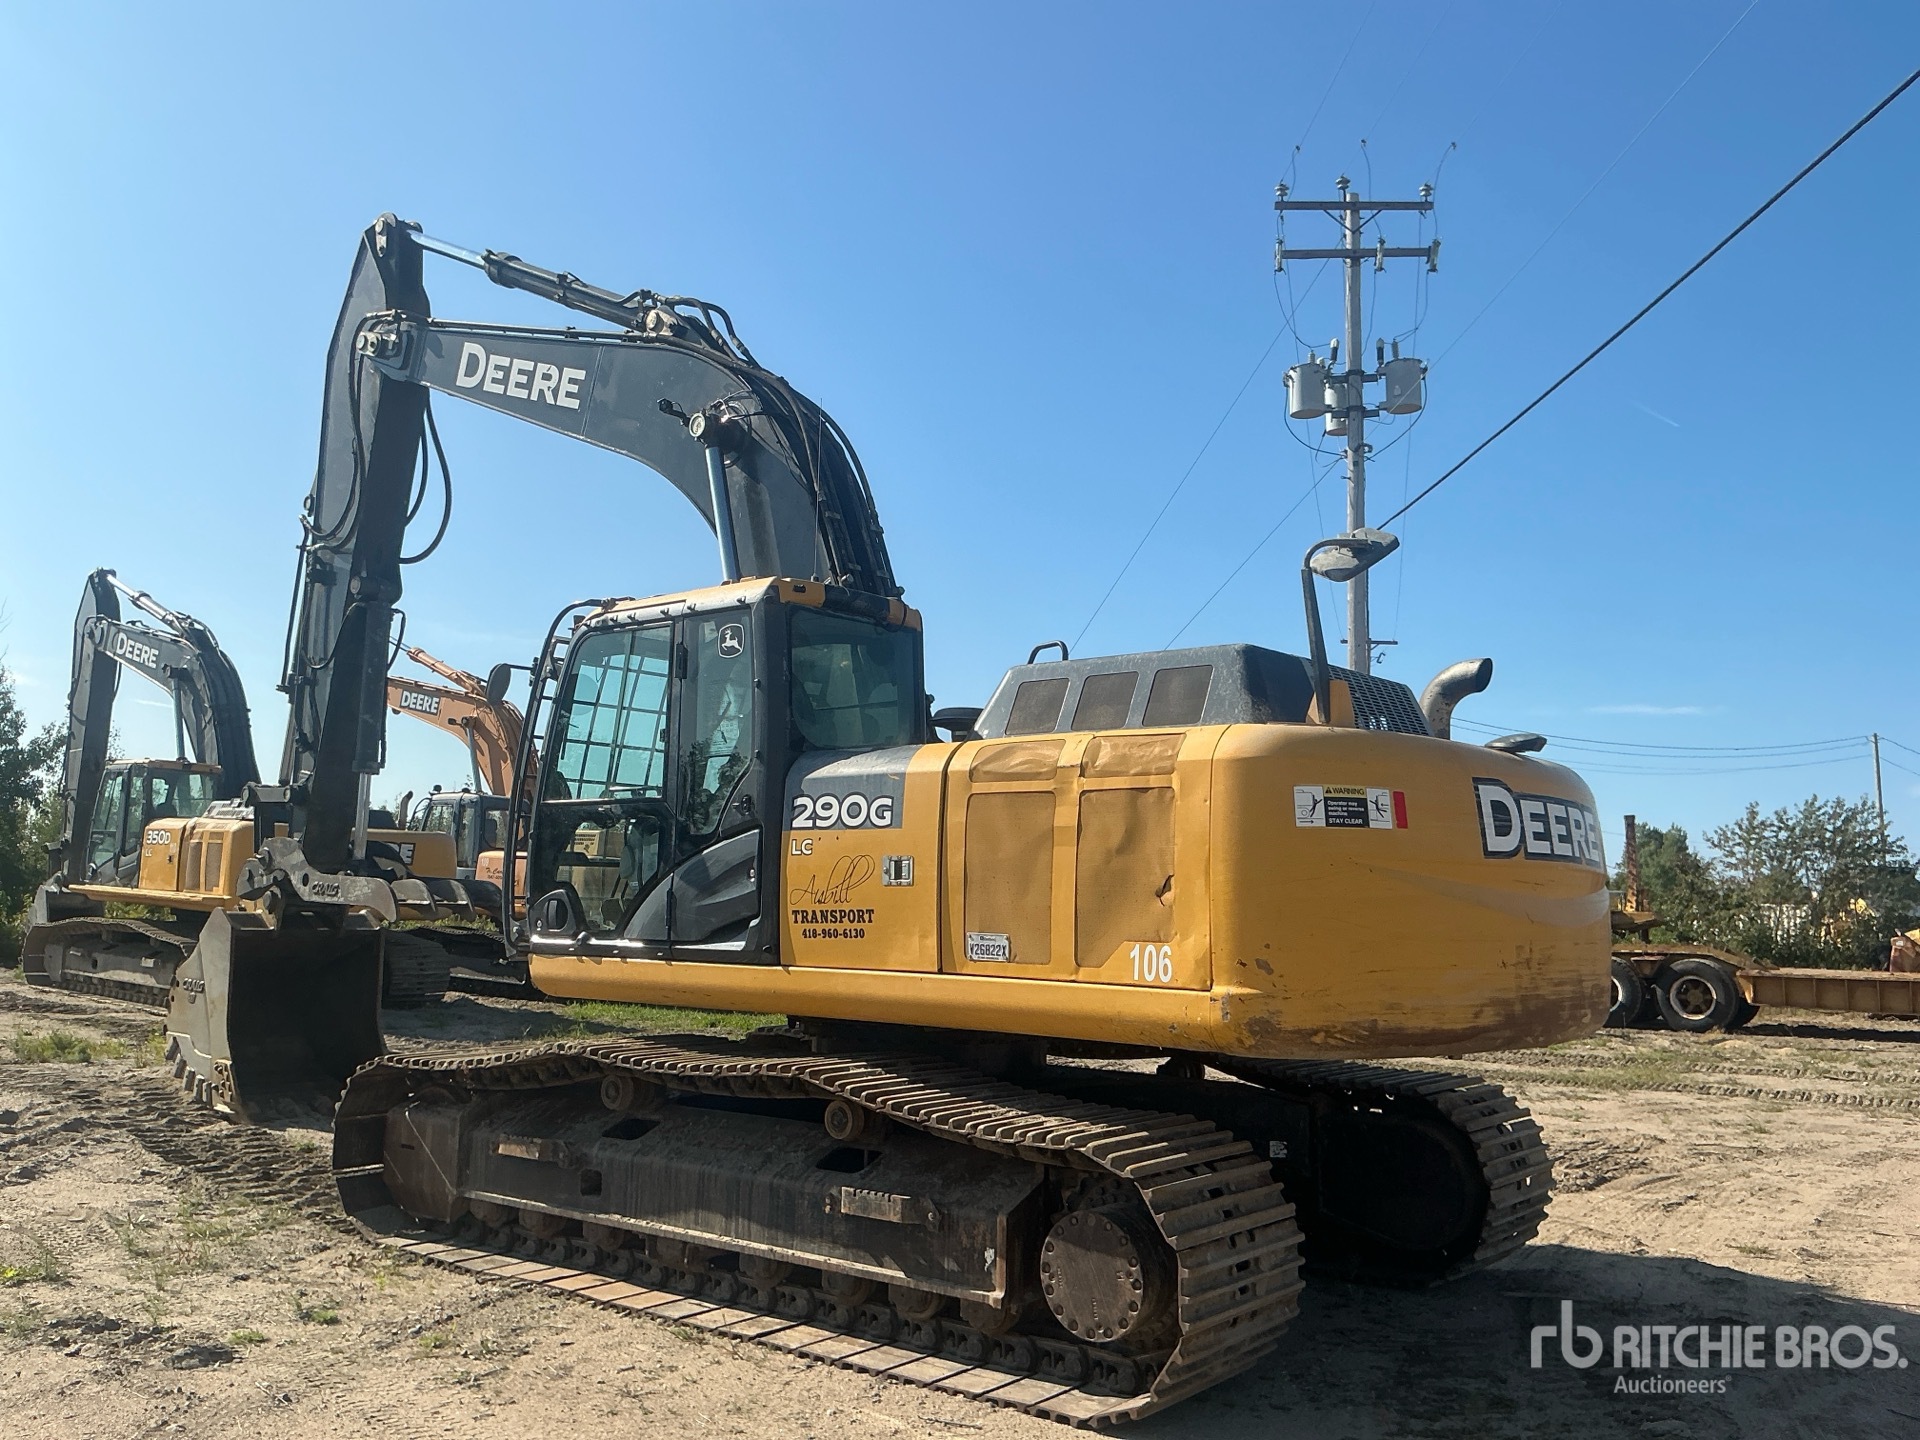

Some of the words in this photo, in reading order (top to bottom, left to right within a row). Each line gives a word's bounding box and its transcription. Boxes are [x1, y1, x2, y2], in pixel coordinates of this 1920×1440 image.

[455, 341, 587, 410] DEERE
[116, 632, 159, 669] DEERE
[400, 690, 440, 714] DEERE
[1332, 787, 1365, 796] WARNING
[790, 793, 894, 830] 290G
[1477, 783, 1600, 864] DEERE
[146, 830, 171, 845] 350D
[791, 839, 813, 856] LC
[791, 909, 875, 924] TRANSPORT
[801, 928, 865, 939] 418-960-6130
[1129, 943, 1173, 983] 106
